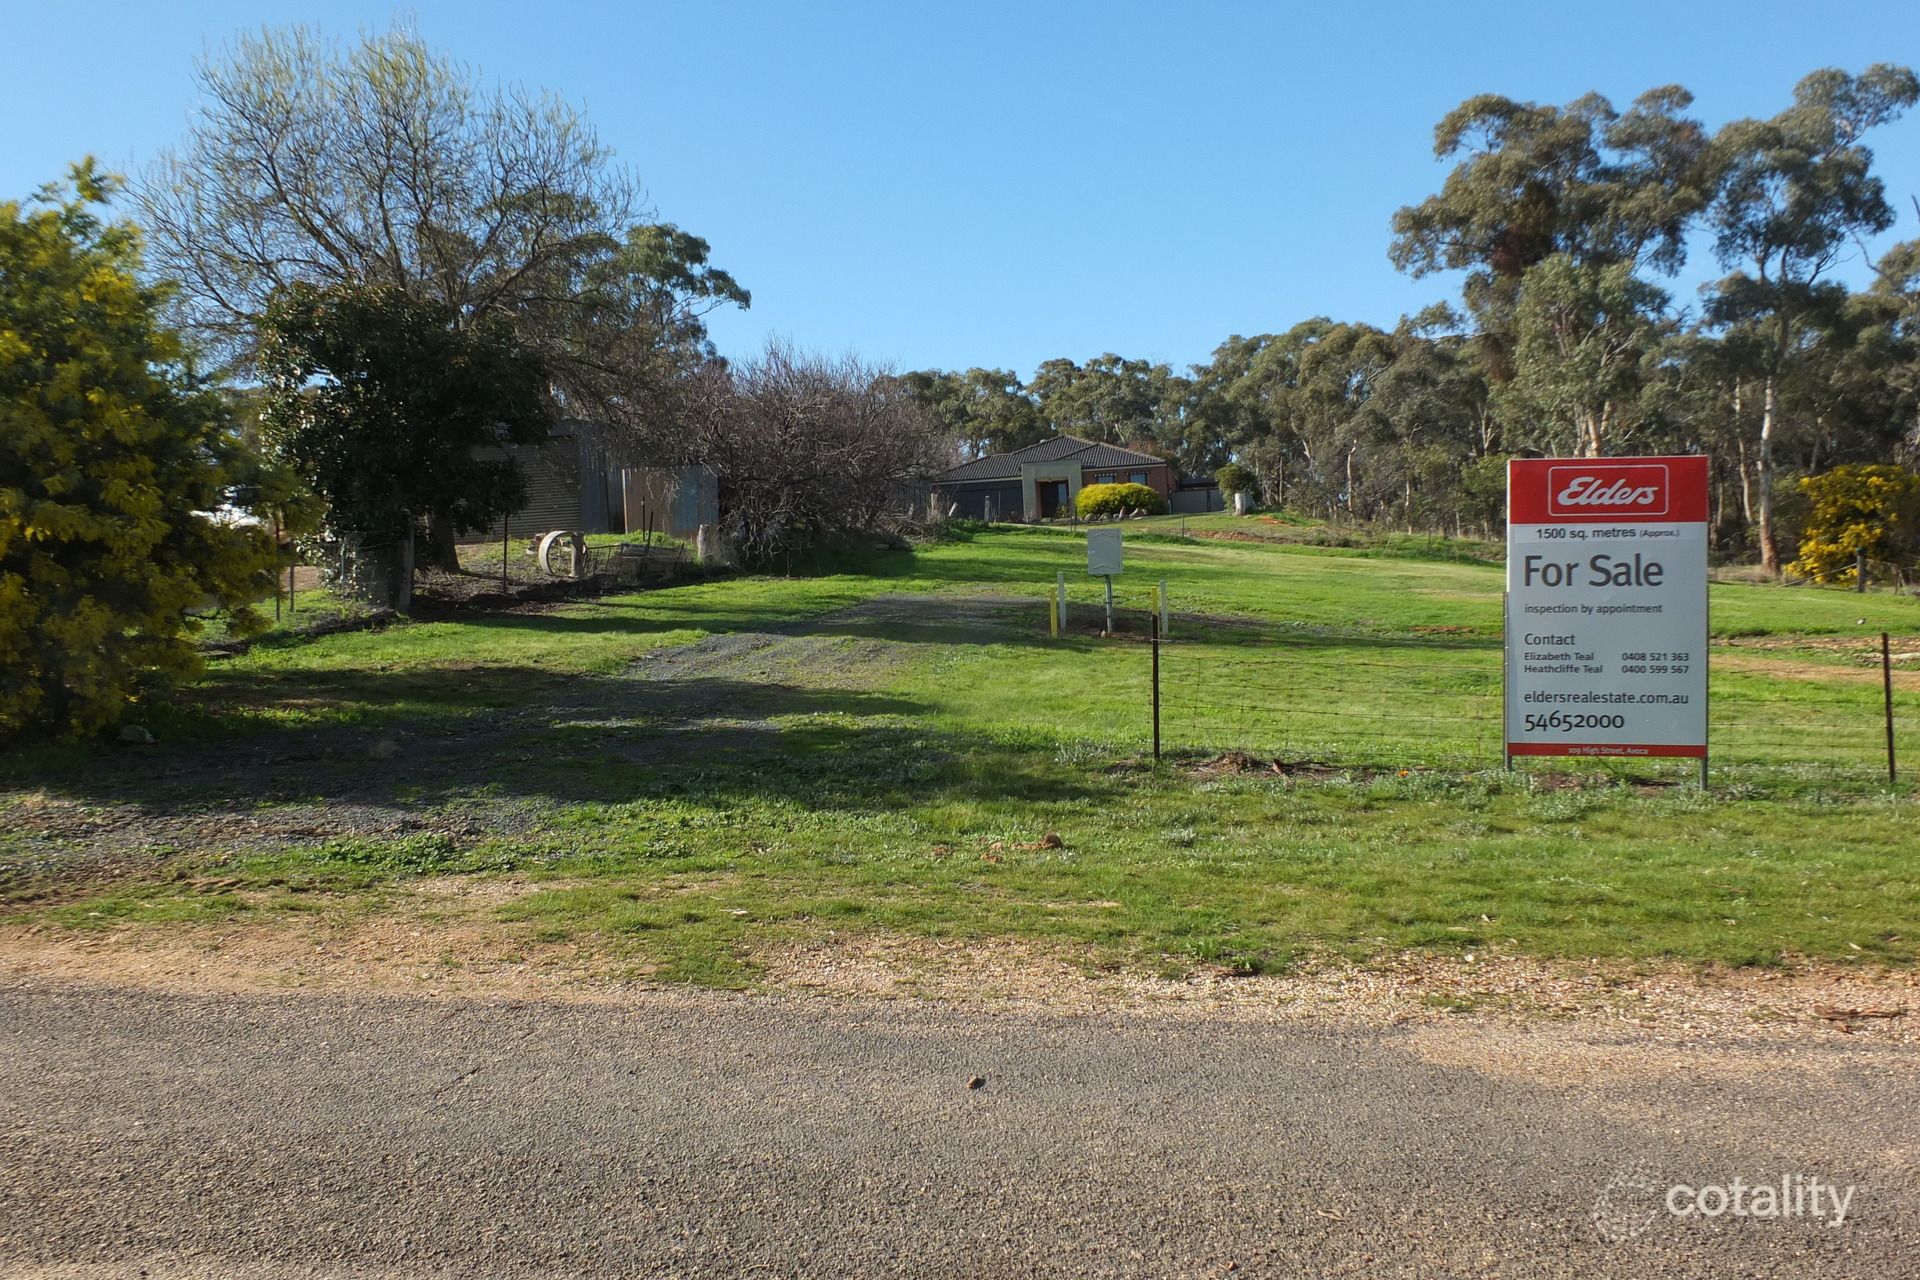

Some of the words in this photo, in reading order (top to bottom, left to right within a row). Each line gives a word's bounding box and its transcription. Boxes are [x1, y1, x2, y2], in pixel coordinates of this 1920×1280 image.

[1557, 476, 1660, 506] Elders
[1536, 528, 1566, 539] 1500
[1569, 530, 1589, 541] sq.
[1592, 528, 1637, 538] metres
[1639, 529, 1680, 539] (Approx.)
[1525, 555, 1579, 587] For
[1589, 553, 1664, 587] Sale
[1524, 604, 1578, 616] inspection
[1580, 604, 1593, 616] by
[1596, 604, 1663, 616] appointment
[1524, 633, 1576, 646] Contact
[1524, 652, 1571, 661] Elizabeth
[1573, 652, 1594, 661] Teal
[1622, 652, 1647, 661] 0408
[1649, 652, 1667, 661] 521
[1671, 652, 1689, 661] 363
[1524, 664, 1580, 674] Heathcliffe
[1582, 664, 1603, 674] Teal
[1622, 665, 1646, 674] 0400
[1649, 665, 1668, 674] 599
[1671, 665, 1689, 674] 567
[1524, 691, 1689, 704] eldersrealestate.com.au
[1525, 710, 1625, 732] 54652000
[1583, 747, 1599, 756] High
